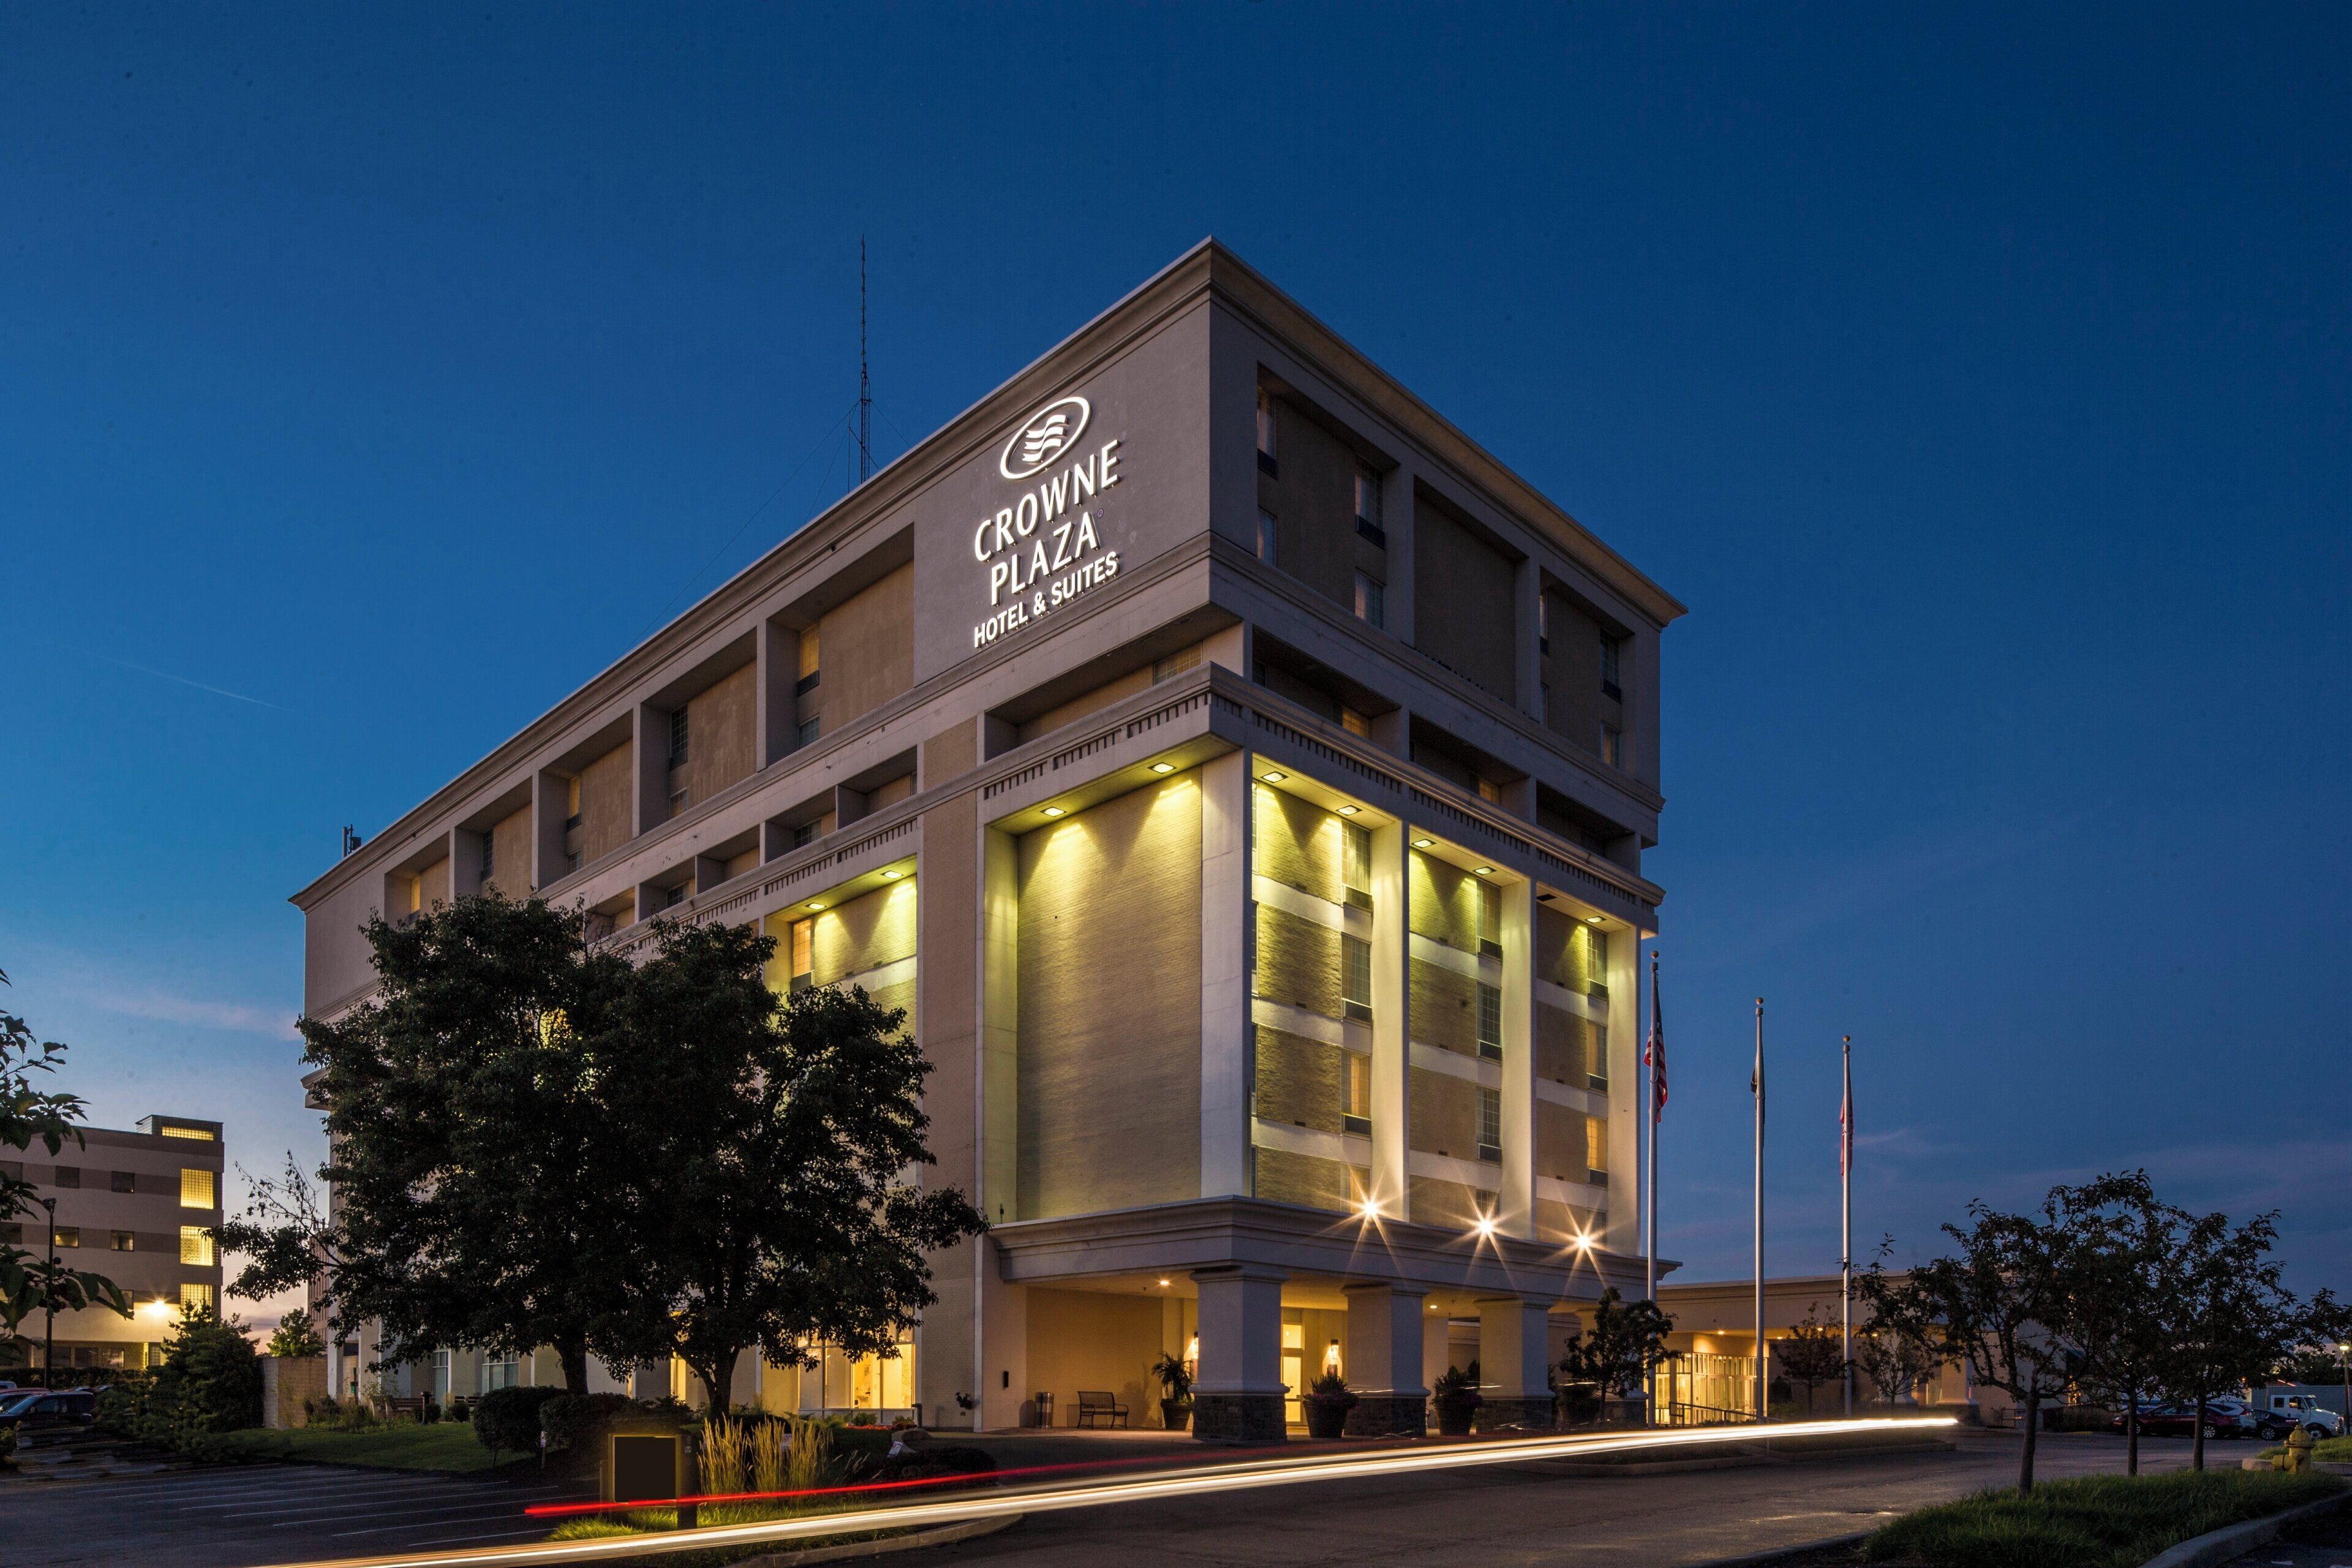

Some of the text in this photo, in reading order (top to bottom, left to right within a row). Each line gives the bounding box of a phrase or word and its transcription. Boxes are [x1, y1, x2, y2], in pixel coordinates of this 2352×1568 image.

[974, 439, 1120, 562] CROWNE
[974, 551, 1119, 649] HOTEL & SUITES
[990, 511, 1100, 606] PLAZA
